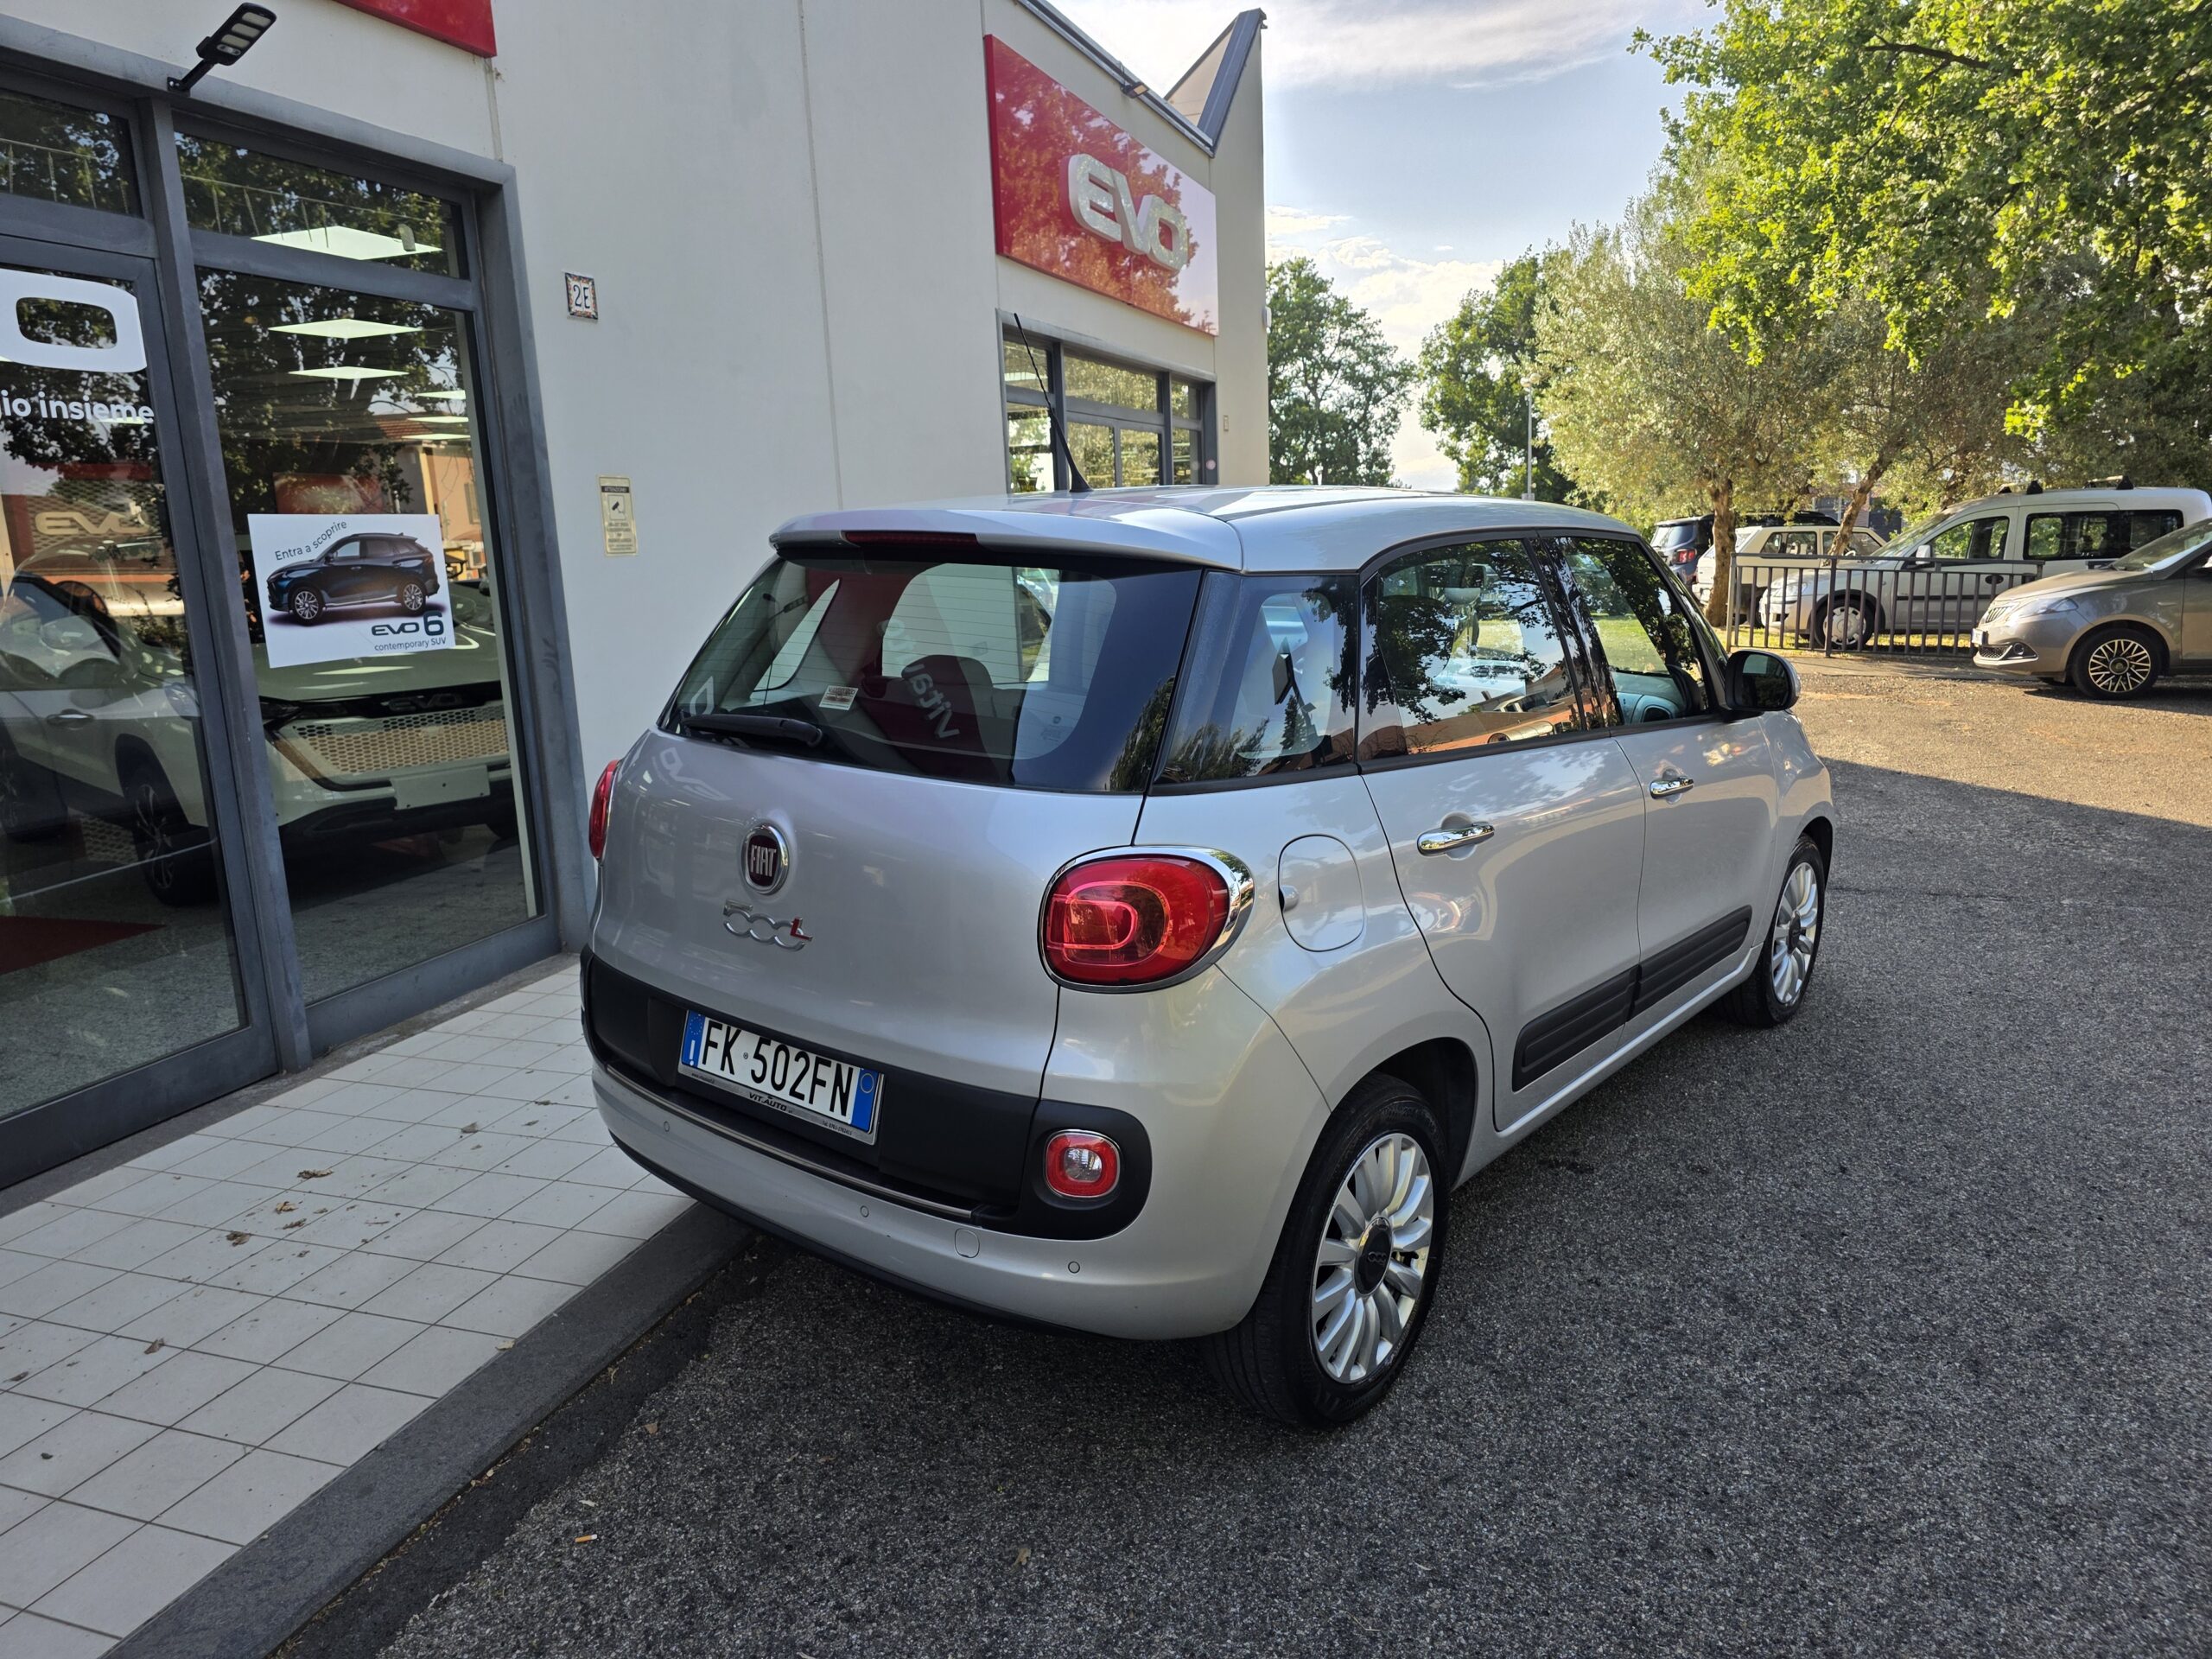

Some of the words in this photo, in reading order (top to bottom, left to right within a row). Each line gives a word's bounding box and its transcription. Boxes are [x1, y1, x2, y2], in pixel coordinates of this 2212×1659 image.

[1068, 153, 1189, 271] EVO
[573, 283, 591, 309] 2E
[0, 389, 32, 417] io
[38, 391, 155, 424] insieme
[275, 546, 303, 561] Entra
[305, 544, 312, 553] a
[313, 520, 347, 549] scoprire
[372, 621, 420, 636] EVO
[423, 610, 445, 637] 6
[374, 639, 429, 652] contemporary
[431, 636, 447, 646] SUV
[750, 844, 777, 877] FIAT
[702, 1020, 742, 1076] FK
[750, 1036, 854, 1117] 502FN
